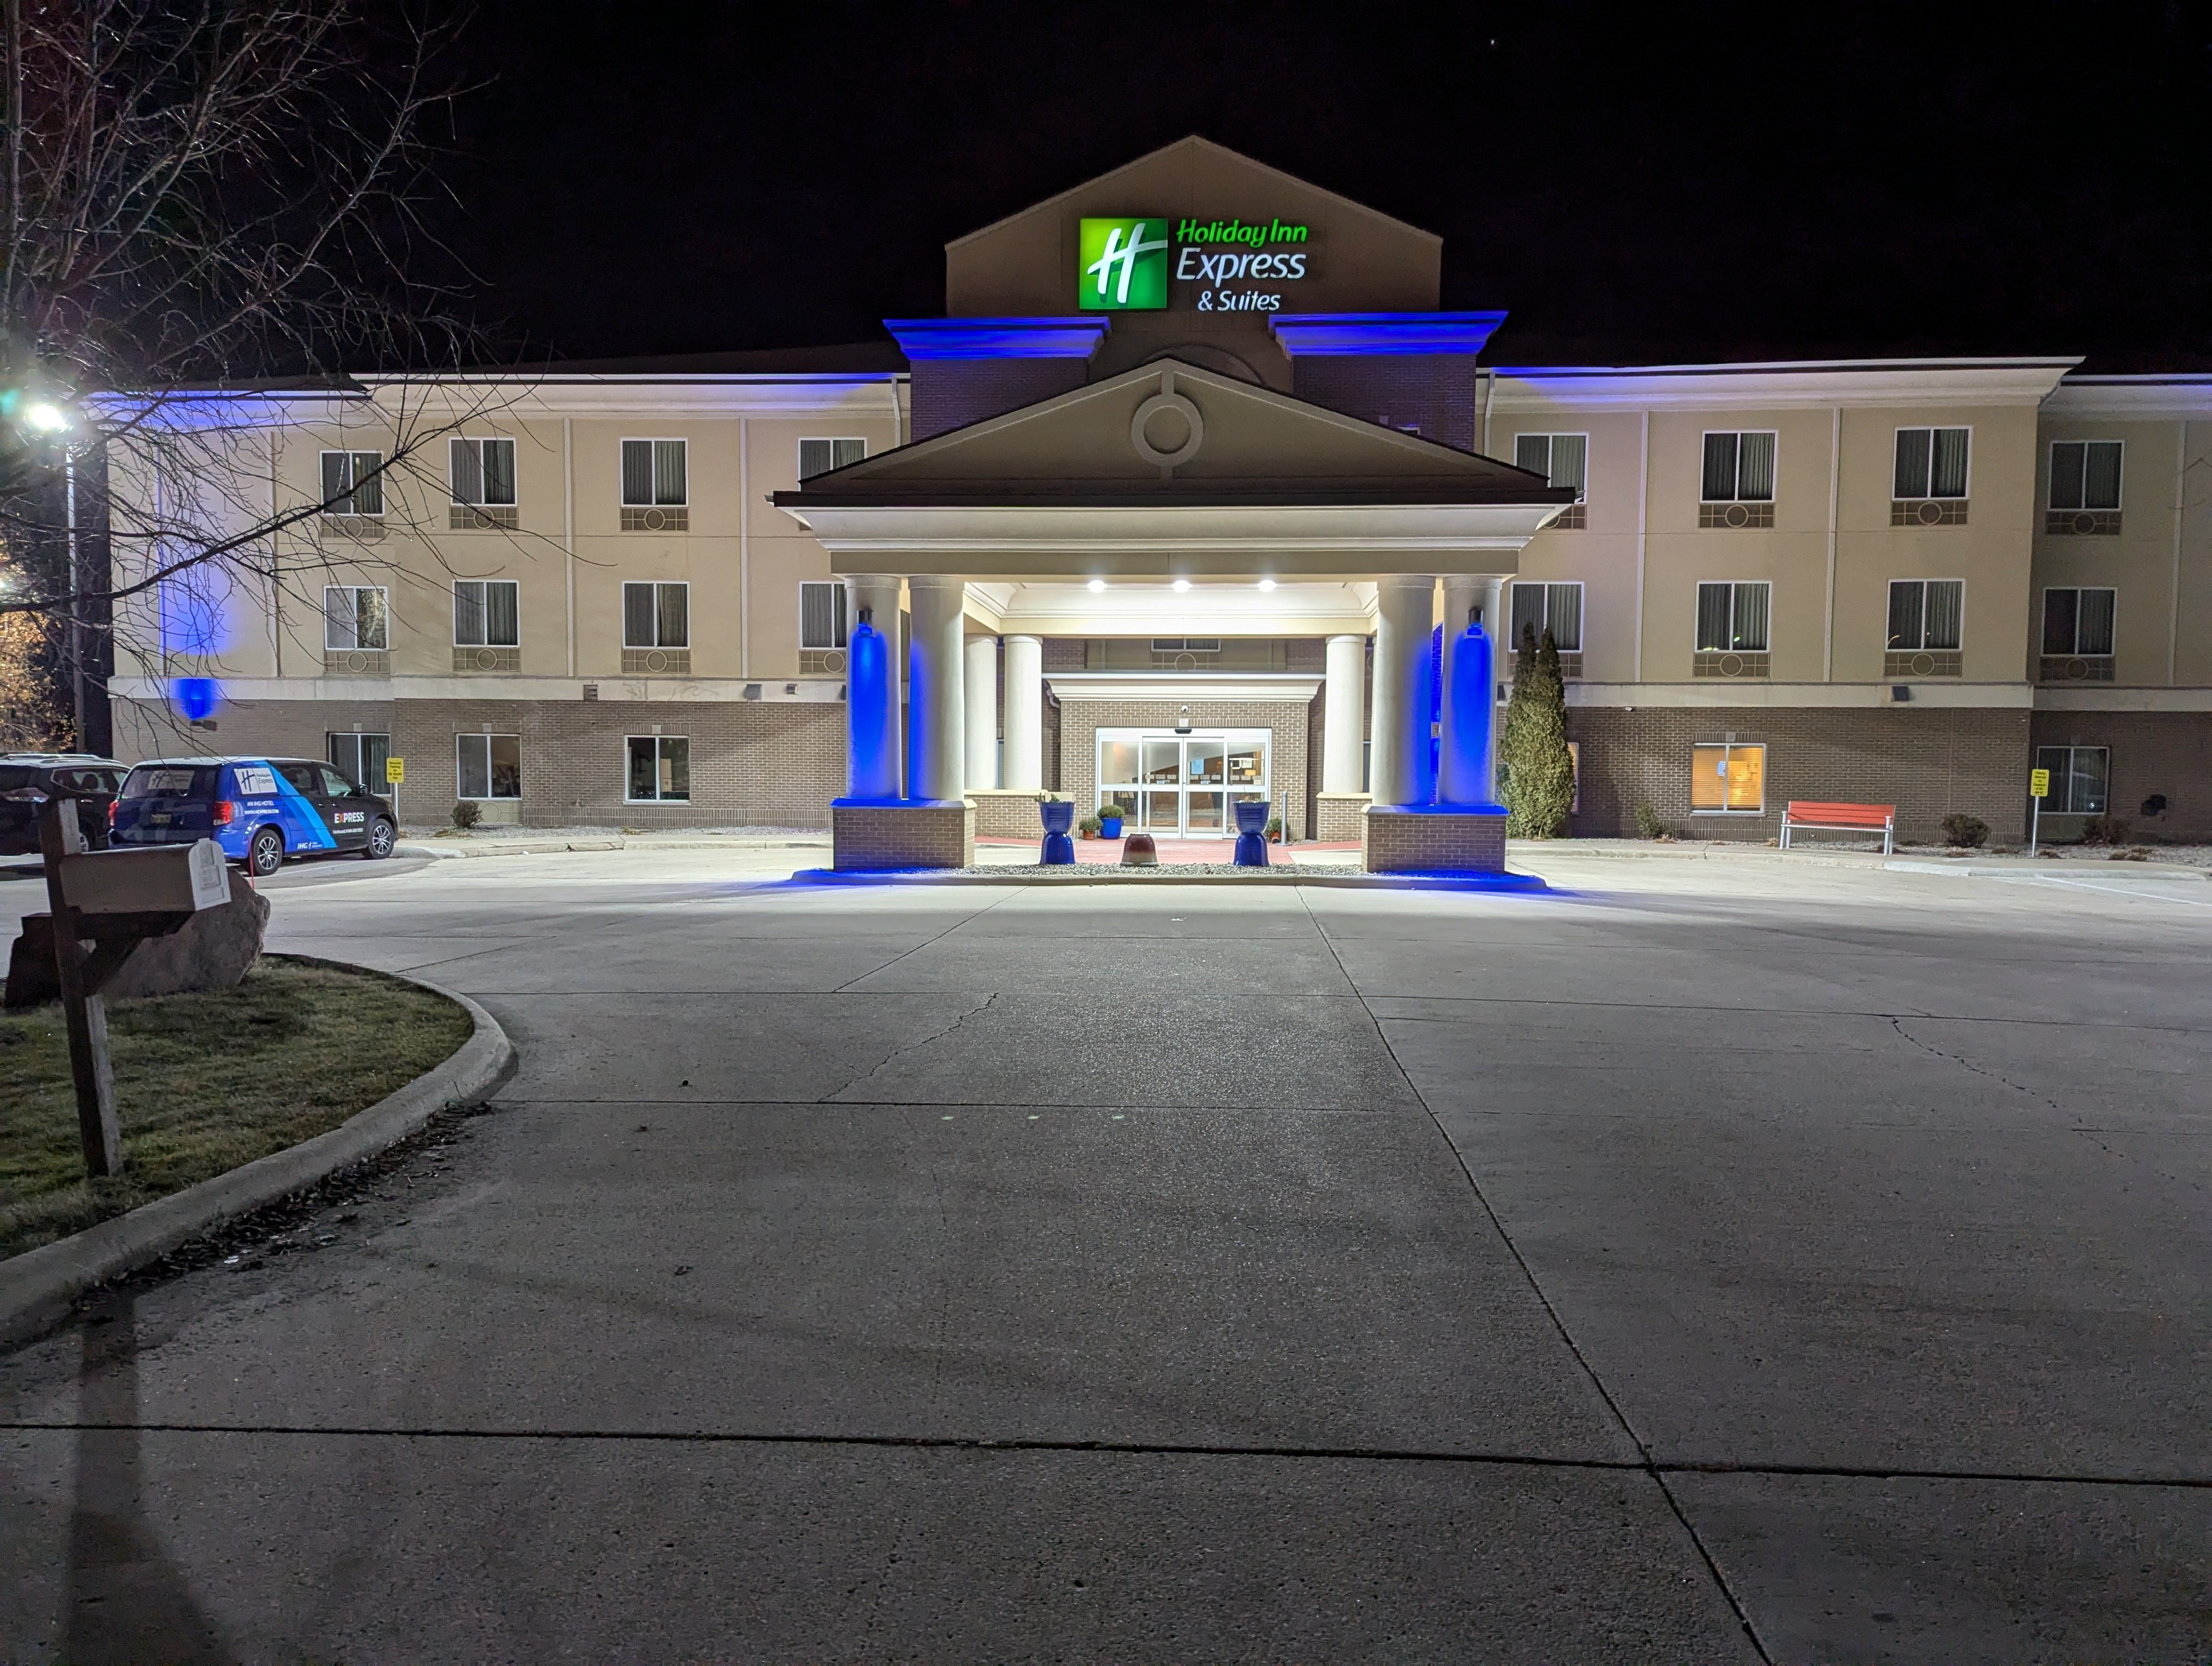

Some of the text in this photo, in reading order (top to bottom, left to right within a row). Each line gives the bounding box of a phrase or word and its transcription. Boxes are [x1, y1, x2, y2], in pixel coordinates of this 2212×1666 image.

[1176, 219, 1308, 248] Holiday Inn
[1176, 247, 1307, 288] Express
[1198, 290, 1281, 311] & Suites
[334, 812, 364, 824] EXPRESS
